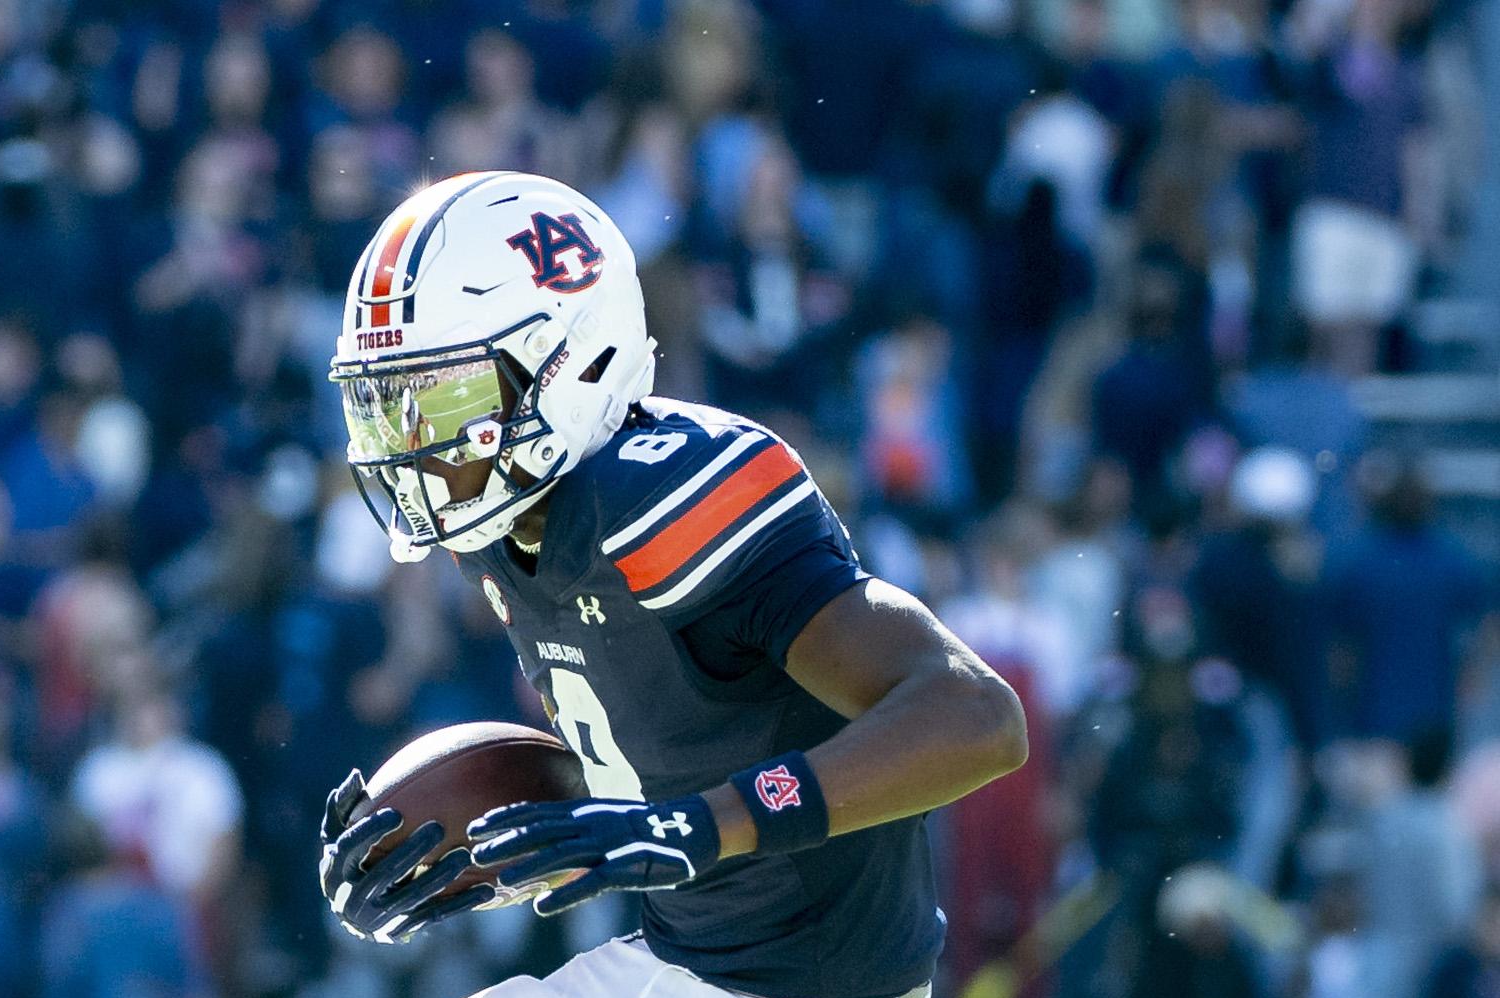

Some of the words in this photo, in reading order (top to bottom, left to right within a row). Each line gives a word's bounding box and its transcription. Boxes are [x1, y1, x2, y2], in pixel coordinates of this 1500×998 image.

[356, 329, 403, 351] TIGERS
[528, 350, 570, 398] IGERS
[618, 431, 688, 465] 8
[536, 641, 586, 666] AUBURN
